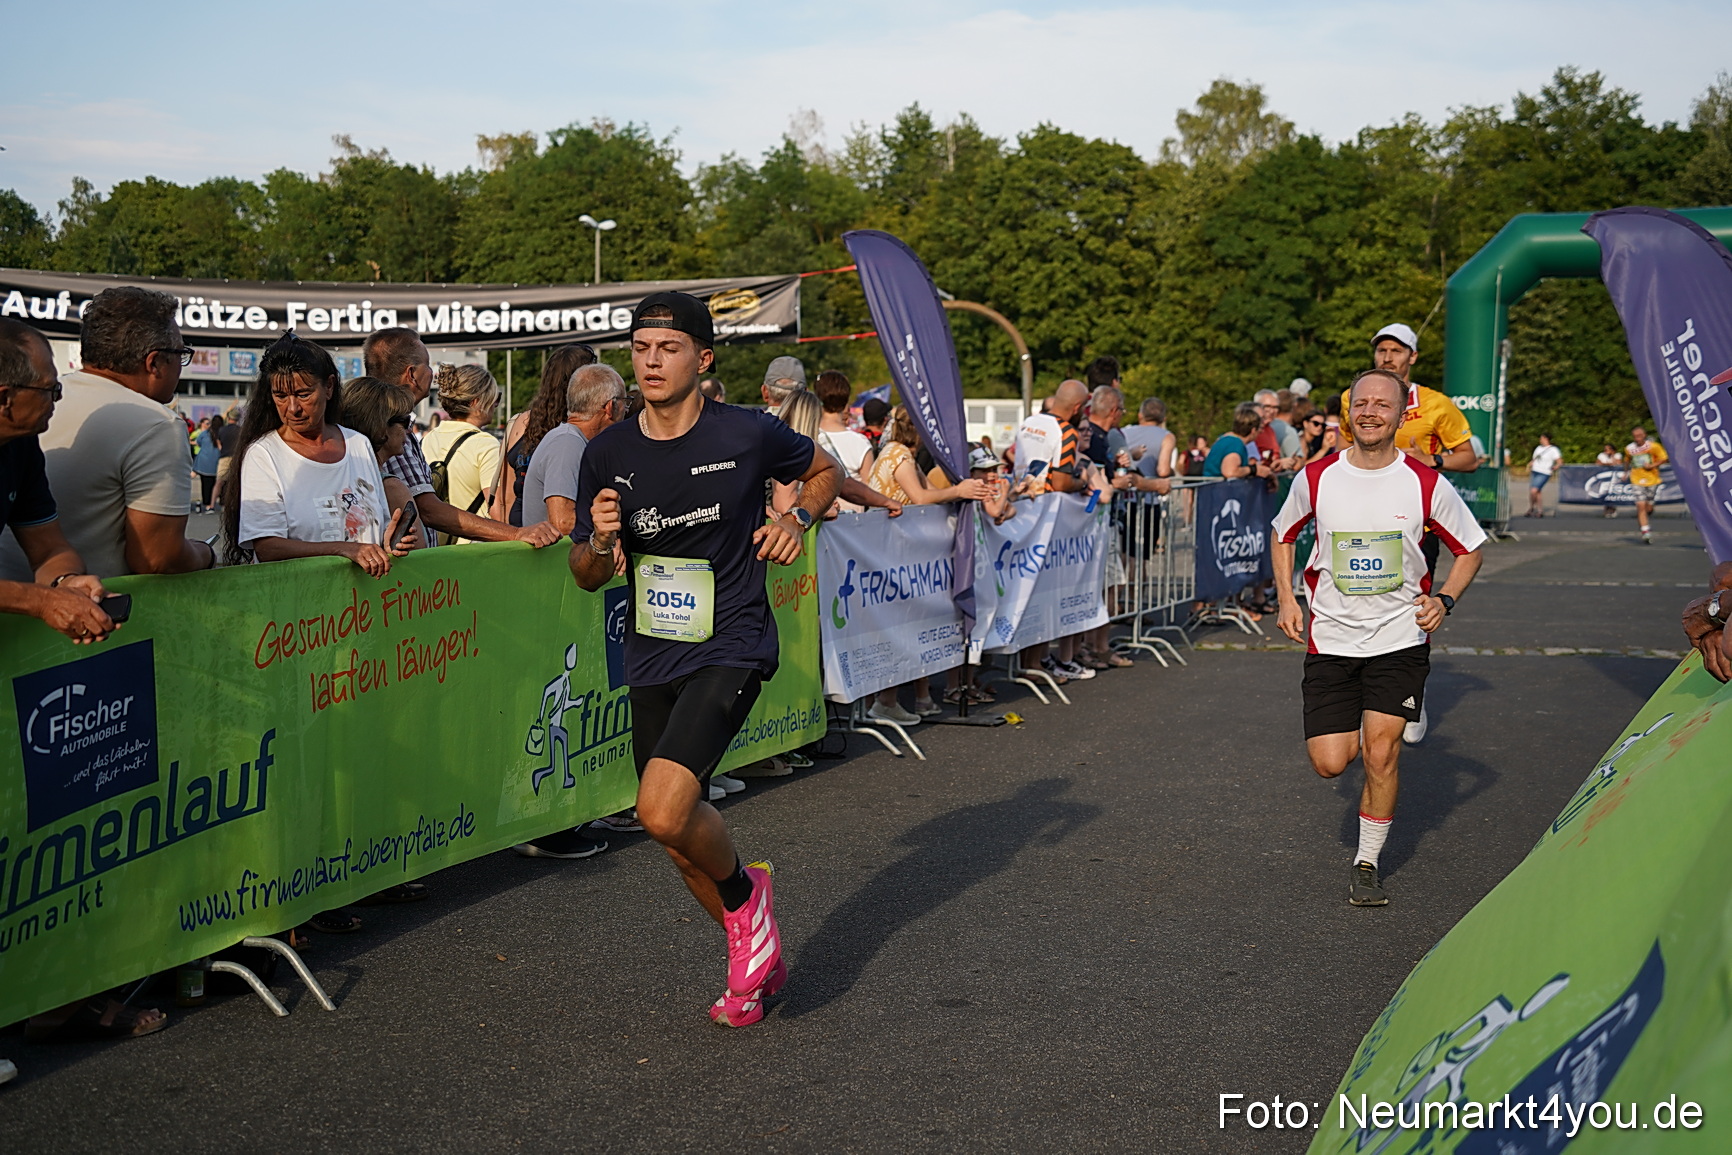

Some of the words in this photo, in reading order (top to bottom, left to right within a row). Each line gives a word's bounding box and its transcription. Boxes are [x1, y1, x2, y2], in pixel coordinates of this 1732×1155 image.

[2, 290, 71, 321] Auf
[175, 297, 279, 330] lätze.
[417, 301, 633, 333] Miteinande
[1451, 395, 1480, 411] OK
[698, 461, 736, 473] PFLEIDERER
[313, 495, 342, 541] ELEG
[661, 503, 720, 528] Firmenlauf
[860, 557, 955, 608] FRISCHMAN
[1349, 558, 1383, 571] 630
[646, 588, 696, 610] 2054
[653, 611, 669, 619] Luka
[671, 612, 691, 621] Tohol
[254, 587, 373, 670] Gesunde
[380, 578, 461, 627] Firmen
[310, 648, 388, 714] laufen
[396, 610, 479, 684] länger!
[50, 695, 134, 744] Fischer
[60, 721, 127, 757] AUTOMOBILE
[92, 754, 109, 770] das
[95, 768, 121, 792] fährt
[123, 752, 147, 773] mit!
[583, 738, 632, 776] neumar
[0, 727, 276, 916] irmenlauf
[0, 880, 103, 951] umarkt
